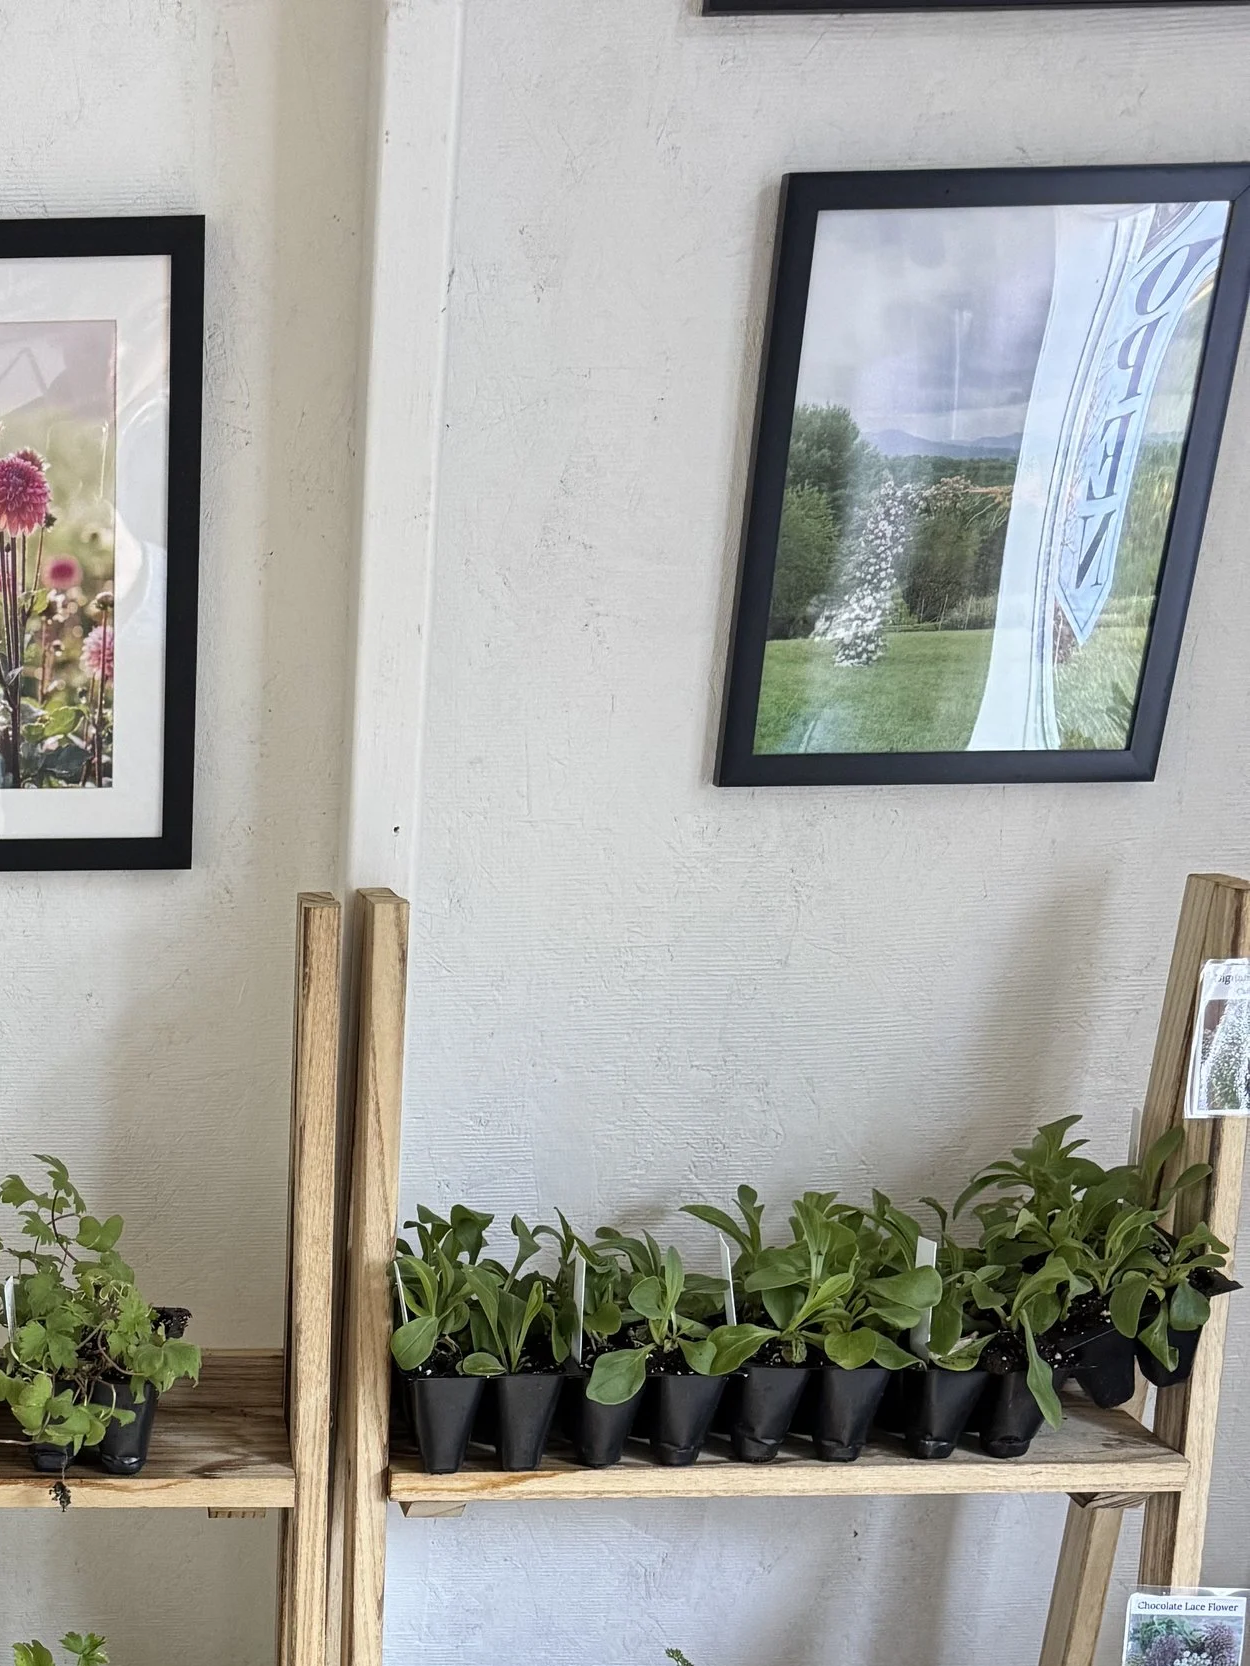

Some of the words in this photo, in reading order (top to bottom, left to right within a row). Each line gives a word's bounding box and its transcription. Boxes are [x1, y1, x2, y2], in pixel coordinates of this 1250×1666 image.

[1137, 1601, 1183, 1610] Chocolate
[1184, 1602, 1206, 1611] Lace
[1208, 1603, 1238, 1612] Flower
